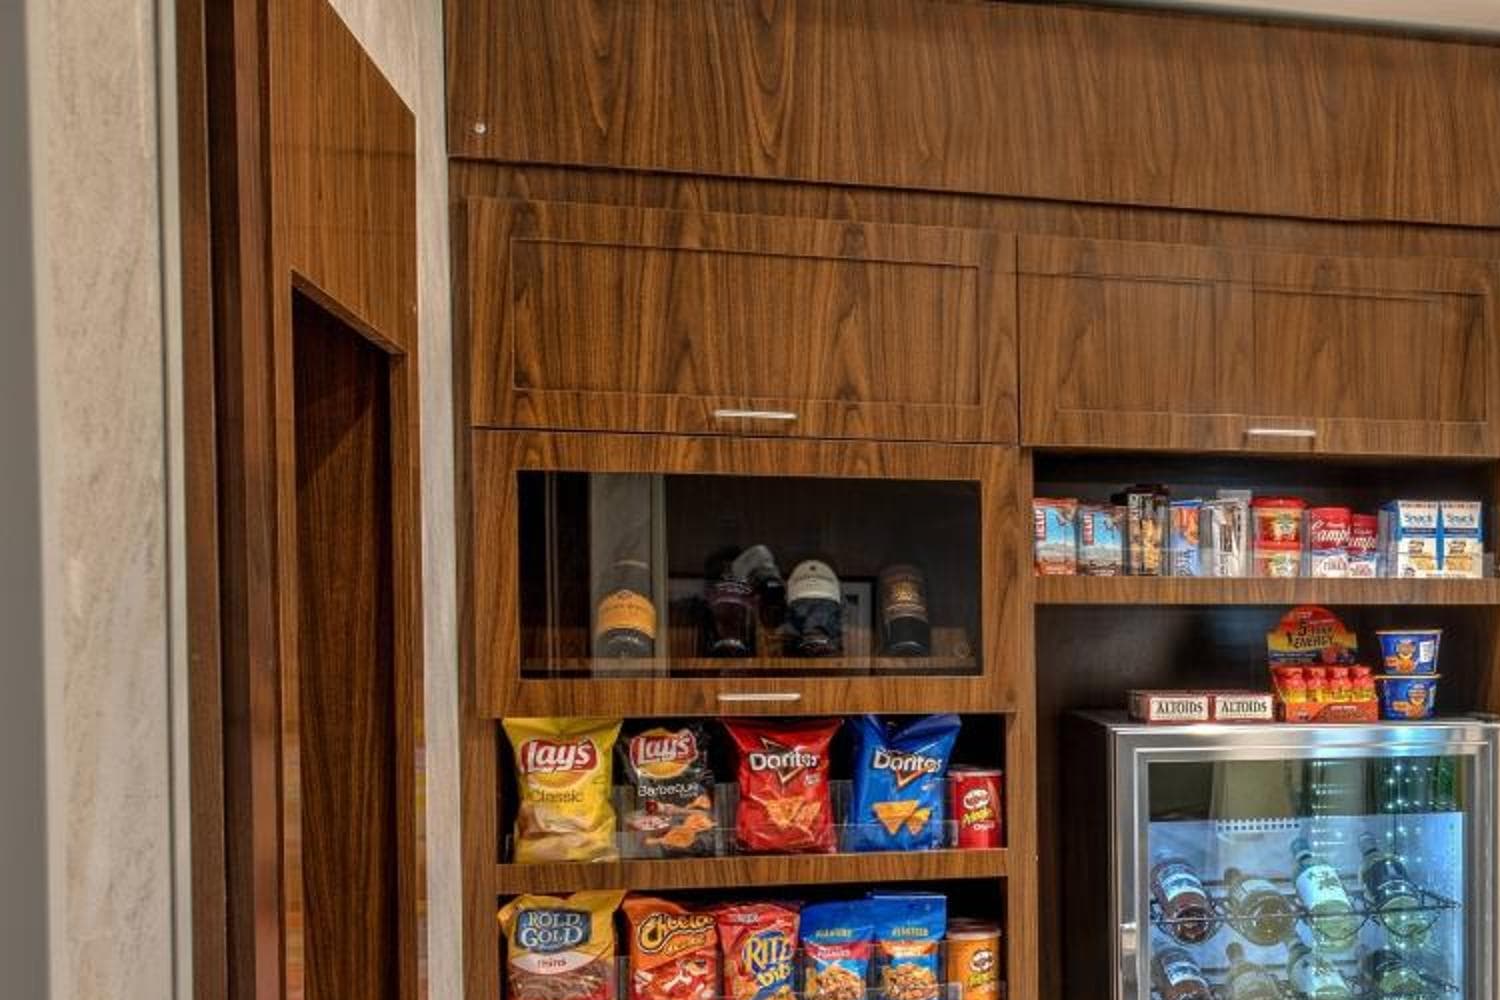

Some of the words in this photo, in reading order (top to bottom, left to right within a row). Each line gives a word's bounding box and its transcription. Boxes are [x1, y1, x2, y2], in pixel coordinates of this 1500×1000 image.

[1155, 700, 1203, 714] ALTOIDS
[1220, 700, 1267, 714] ALTOIDS
[528, 738, 593, 774] Lay's
[639, 732, 691, 764] Lay's
[750, 751, 821, 773] Doritos
[872, 748, 942, 774] Doritos
[528, 911, 581, 928] ROLD
[521, 925, 583, 947] GOLD
[745, 933, 794, 969] RITZ
